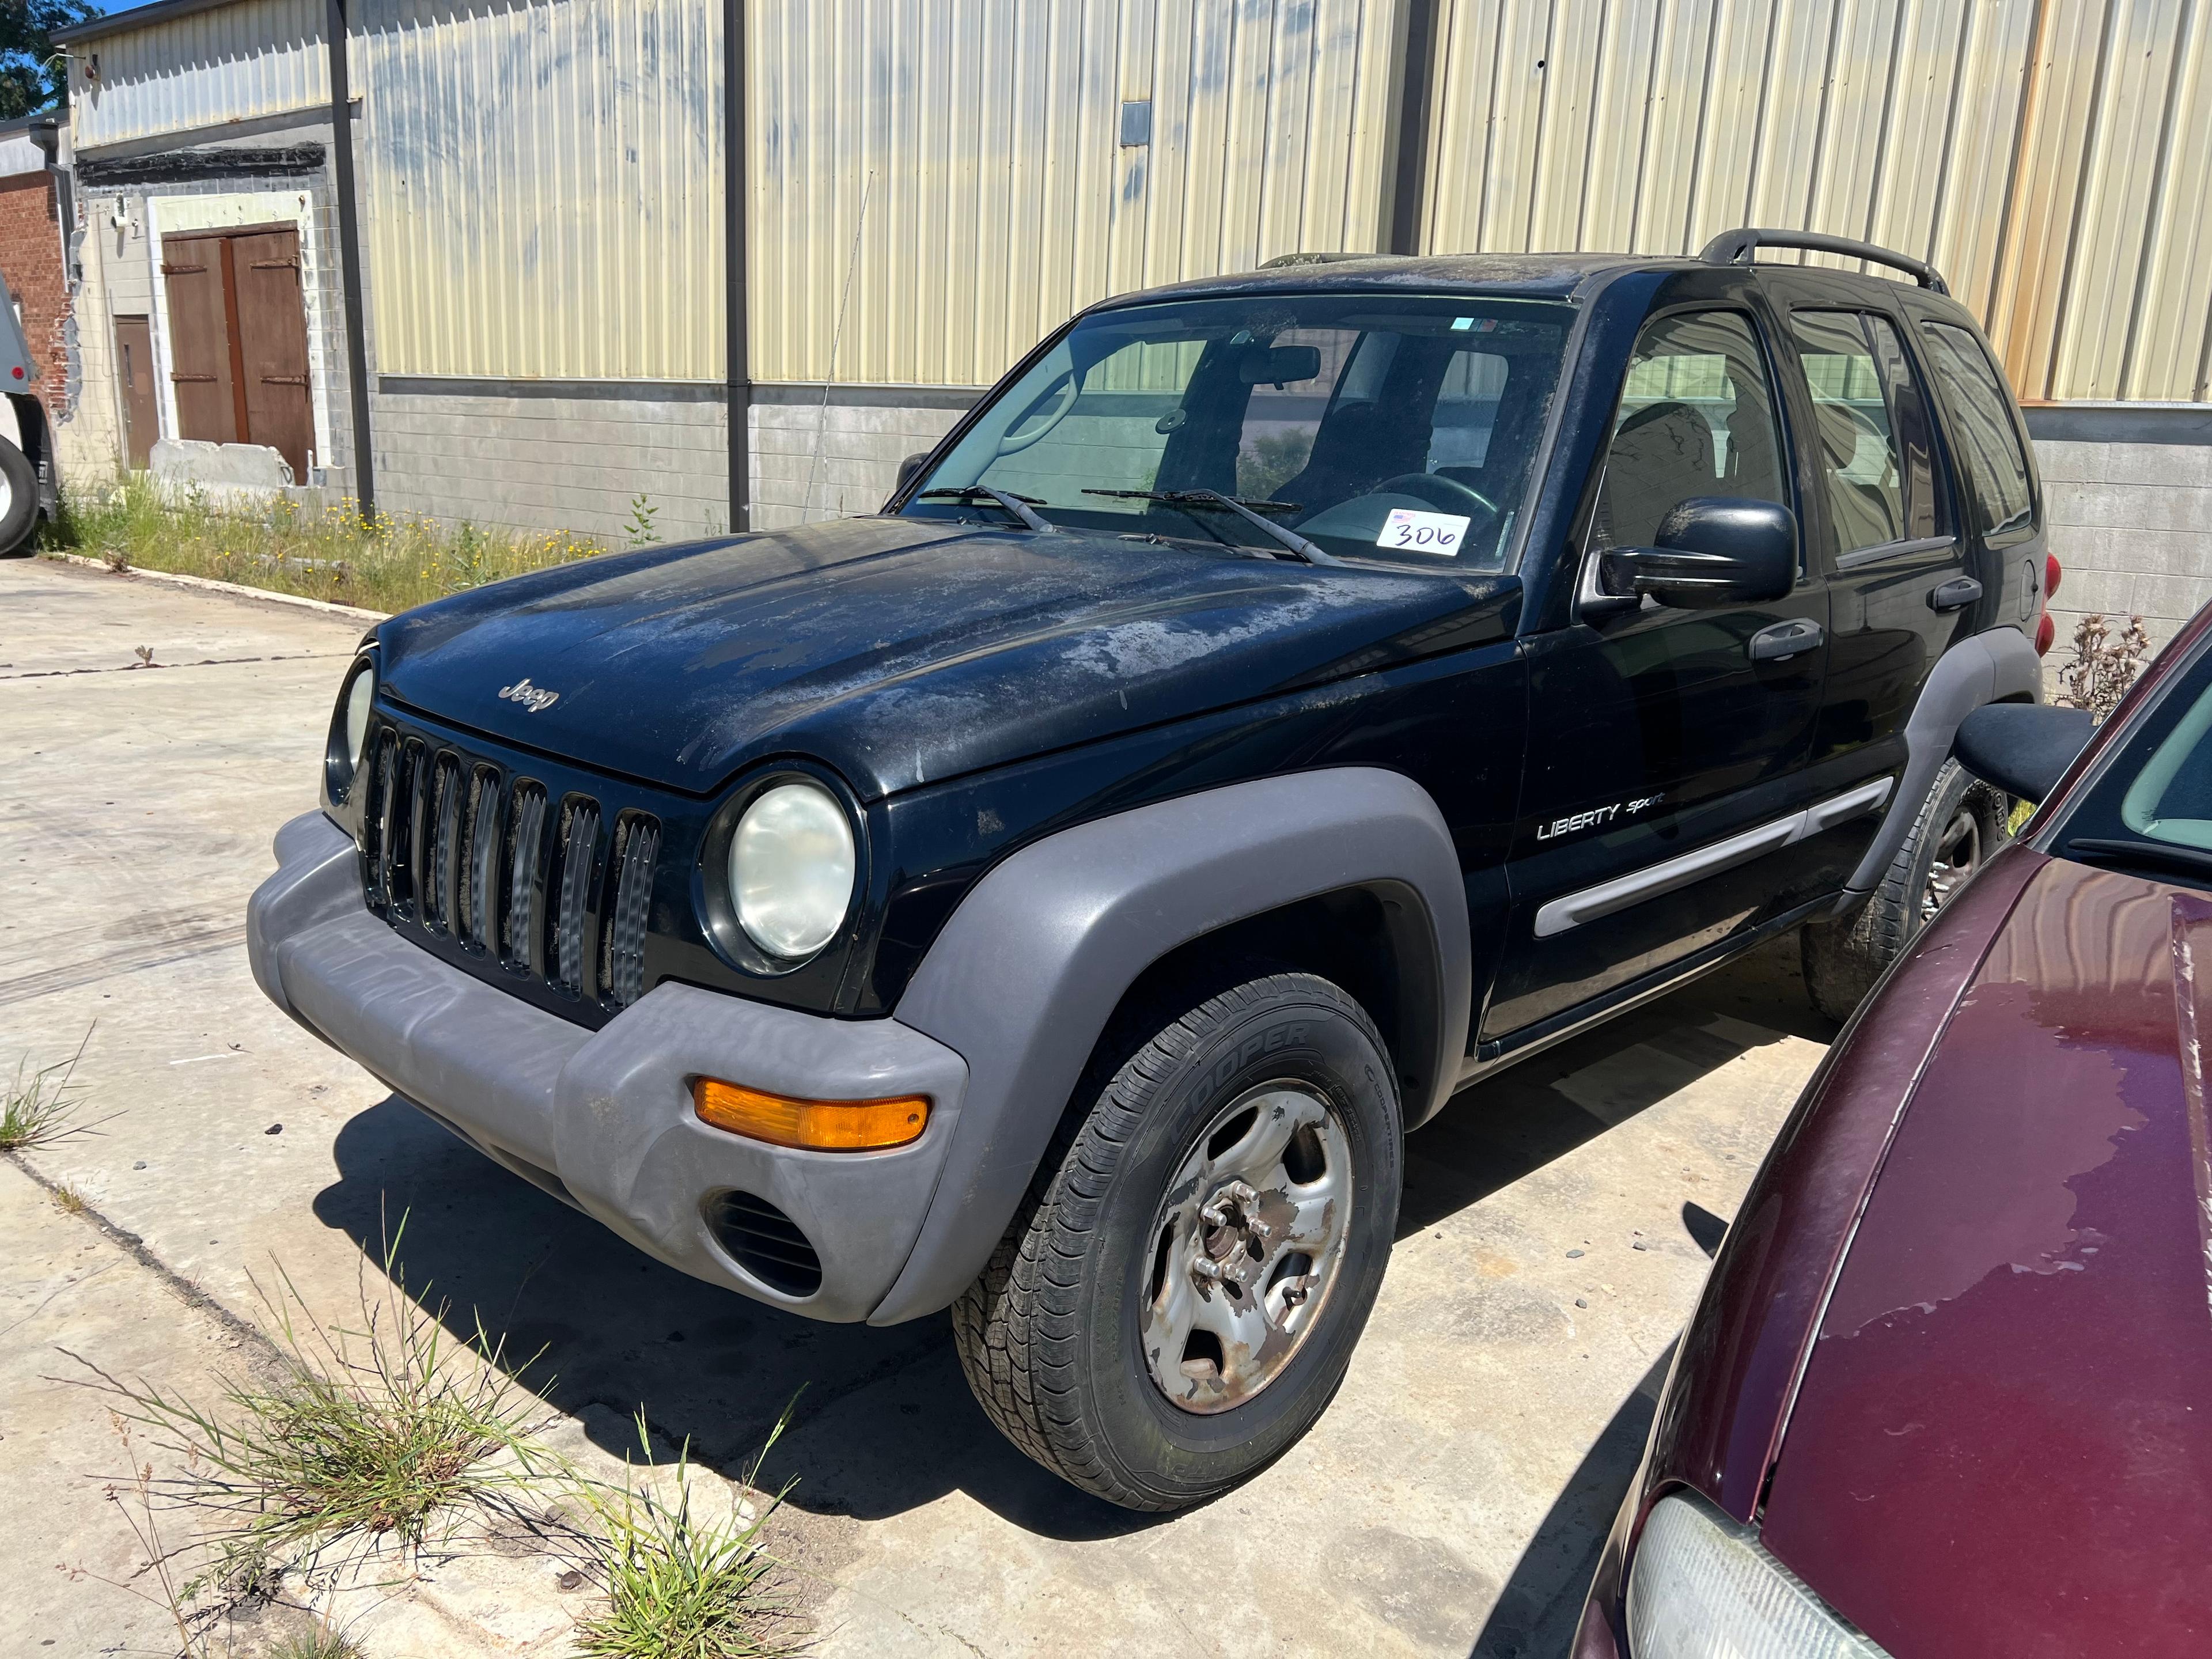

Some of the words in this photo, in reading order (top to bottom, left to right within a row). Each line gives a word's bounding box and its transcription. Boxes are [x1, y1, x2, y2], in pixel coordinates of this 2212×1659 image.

[1395, 524, 1455, 546] 306
[498, 678, 559, 713] Jeep
[1536, 804, 1621, 841] LIBERTY
[1169, 1022, 1311, 1146] COOPER
